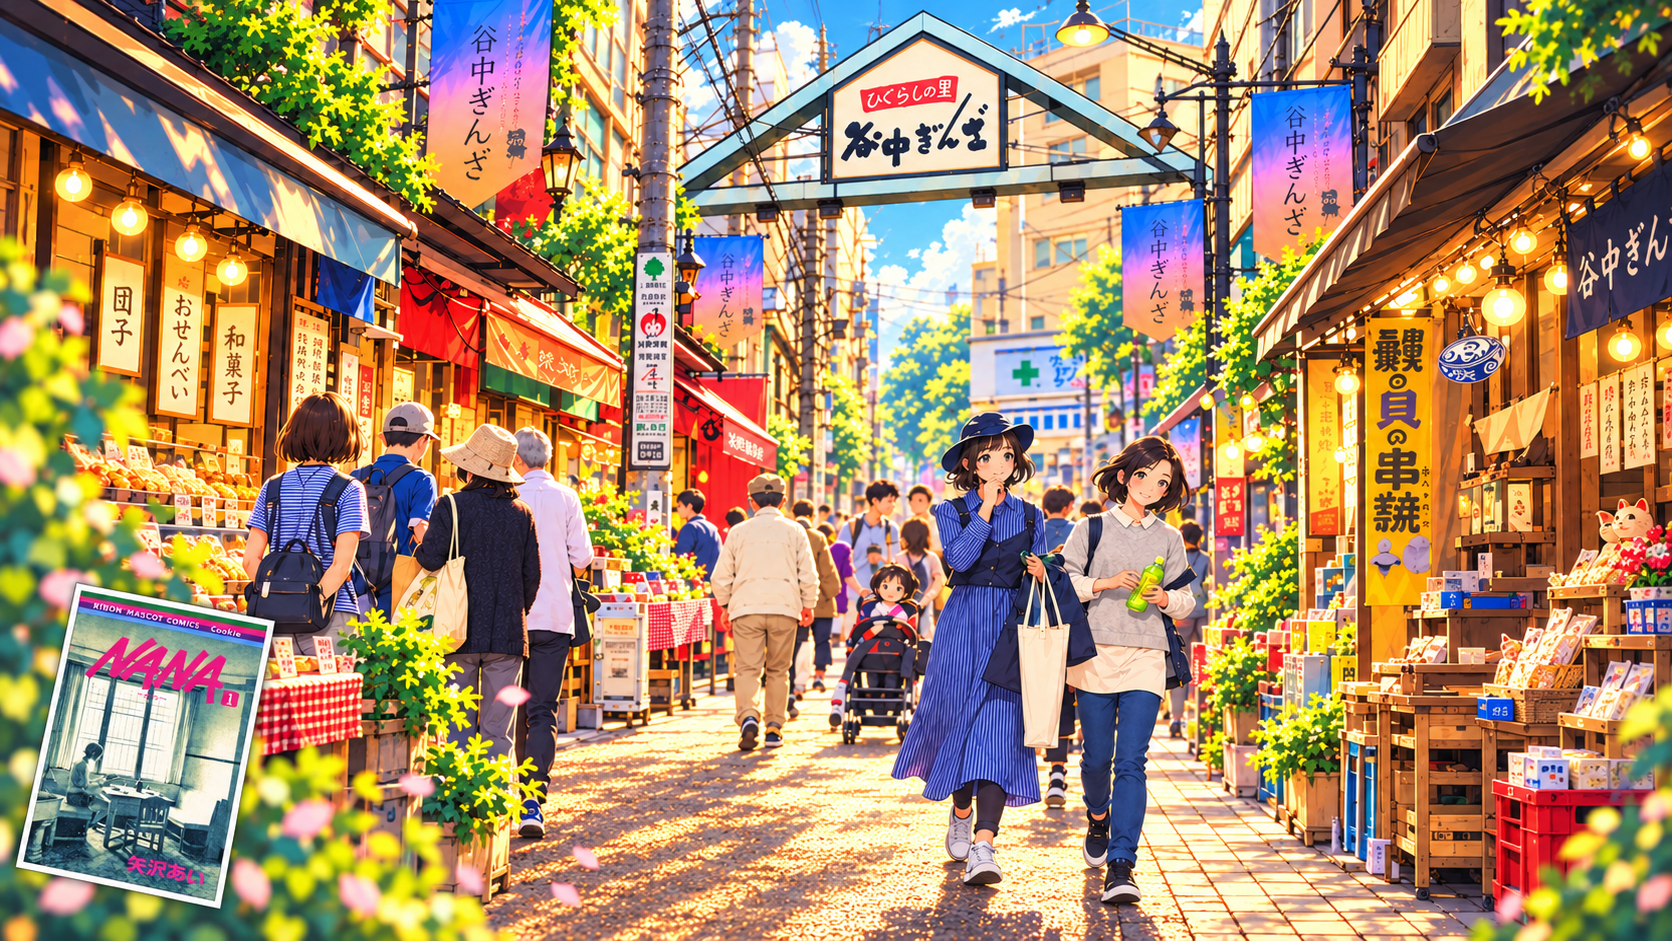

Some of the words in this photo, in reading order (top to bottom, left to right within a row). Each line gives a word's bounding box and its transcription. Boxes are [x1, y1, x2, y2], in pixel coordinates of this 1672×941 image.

[463, 24, 498, 181] 谷中ぎんざ
[840, 92, 989, 168] 谷中ぎんざ
[866, 79, 952, 109] ひぐらしの里
[1284, 105, 1308, 236] 谷中ぎんざ
[1149, 218, 1169, 324] 谷中ぎんざ
[1577, 206, 1672, 300] 谷中ぎん
[111, 285, 133, 347] 団子
[717, 252, 736, 338] 谷中ぎんざ
[170, 294, 193, 400] おせんべい
[222, 324, 245, 406] 和菓子
[126, 609, 164, 622] MASCOT
[166, 617, 200, 630] COMICS
[210, 625, 242, 638] Cookie
[85, 636, 227, 704] NANA
[226, 692, 233, 706] 1
[126, 854, 205, 886] 矢沢あい
